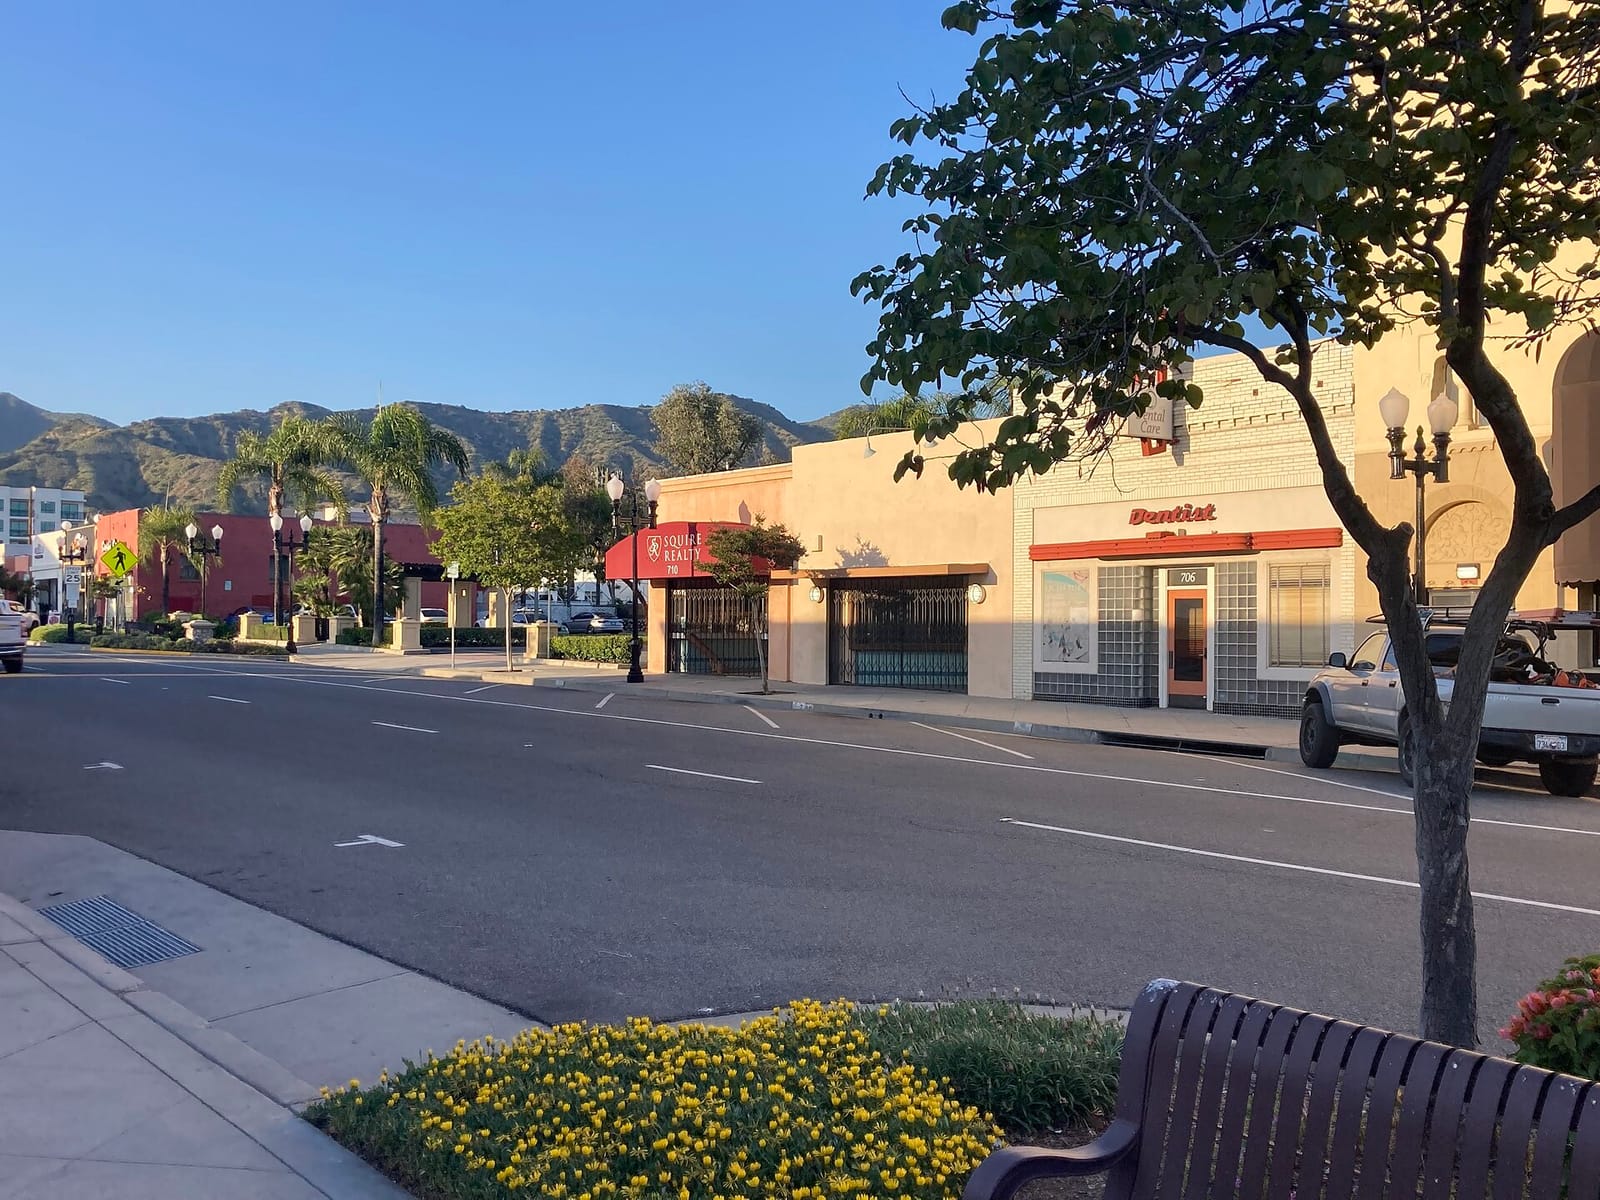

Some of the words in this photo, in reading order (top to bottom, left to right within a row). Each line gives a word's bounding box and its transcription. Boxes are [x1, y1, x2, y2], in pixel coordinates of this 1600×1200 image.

[1136, 408, 1166, 422] ental
[1140, 420, 1161, 434] Care
[1129, 503, 1217, 525] Dentist
[664, 533, 702, 549] SQUIRE
[664, 548, 701, 562] REALTY
[667, 565, 679, 575] 710
[66, 574, 81, 583] 25
[1180, 572, 1197, 583] 706
